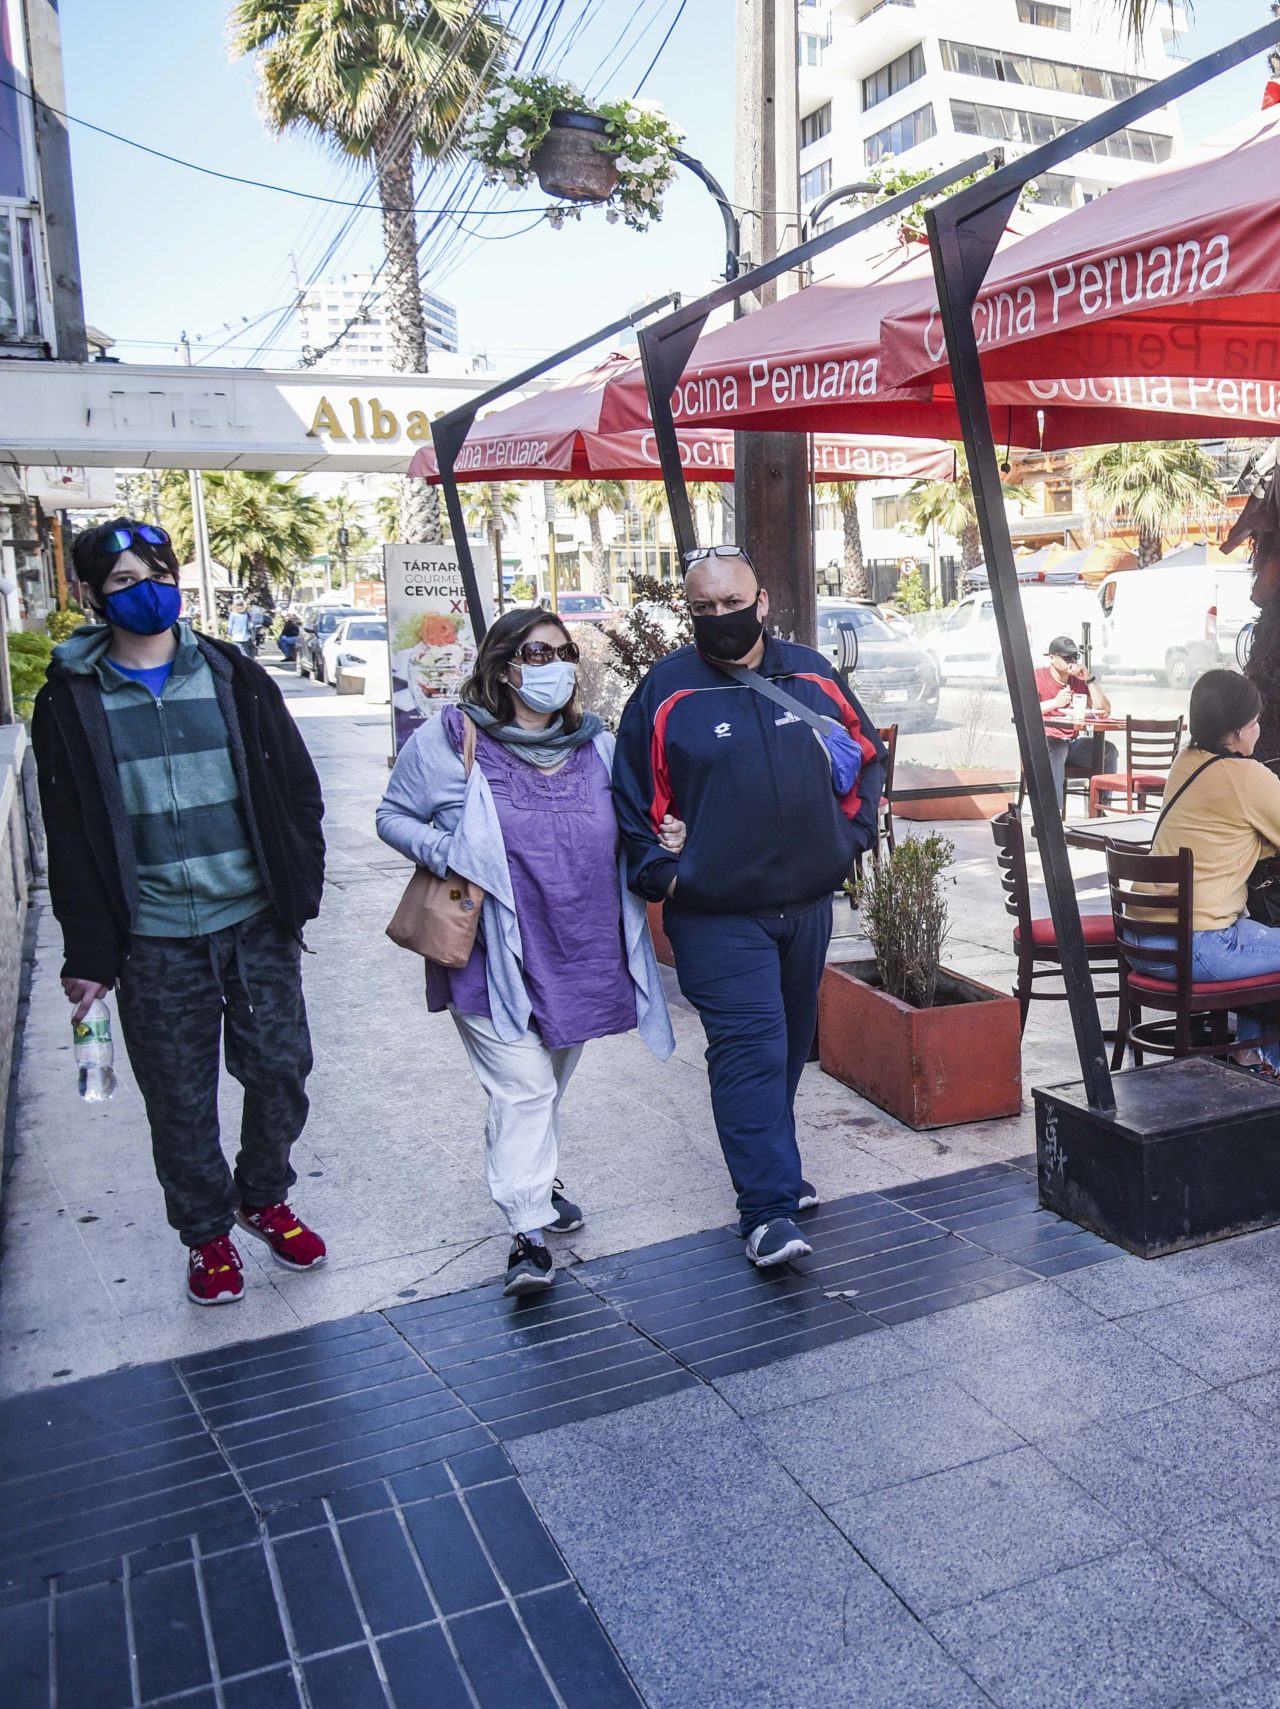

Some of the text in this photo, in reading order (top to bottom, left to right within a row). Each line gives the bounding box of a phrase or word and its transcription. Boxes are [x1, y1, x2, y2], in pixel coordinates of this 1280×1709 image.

[923, 234, 1230, 361] Ccina Peruana
[647, 358, 879, 420] ocina Peruana
[306, 395, 498, 441] Alba
[485, 440, 549, 467] Peruana
[641, 432, 907, 472] Cocin eruana
[403, 559, 475, 572] TÁRTAR
[404, 574, 462, 584] GOURME
